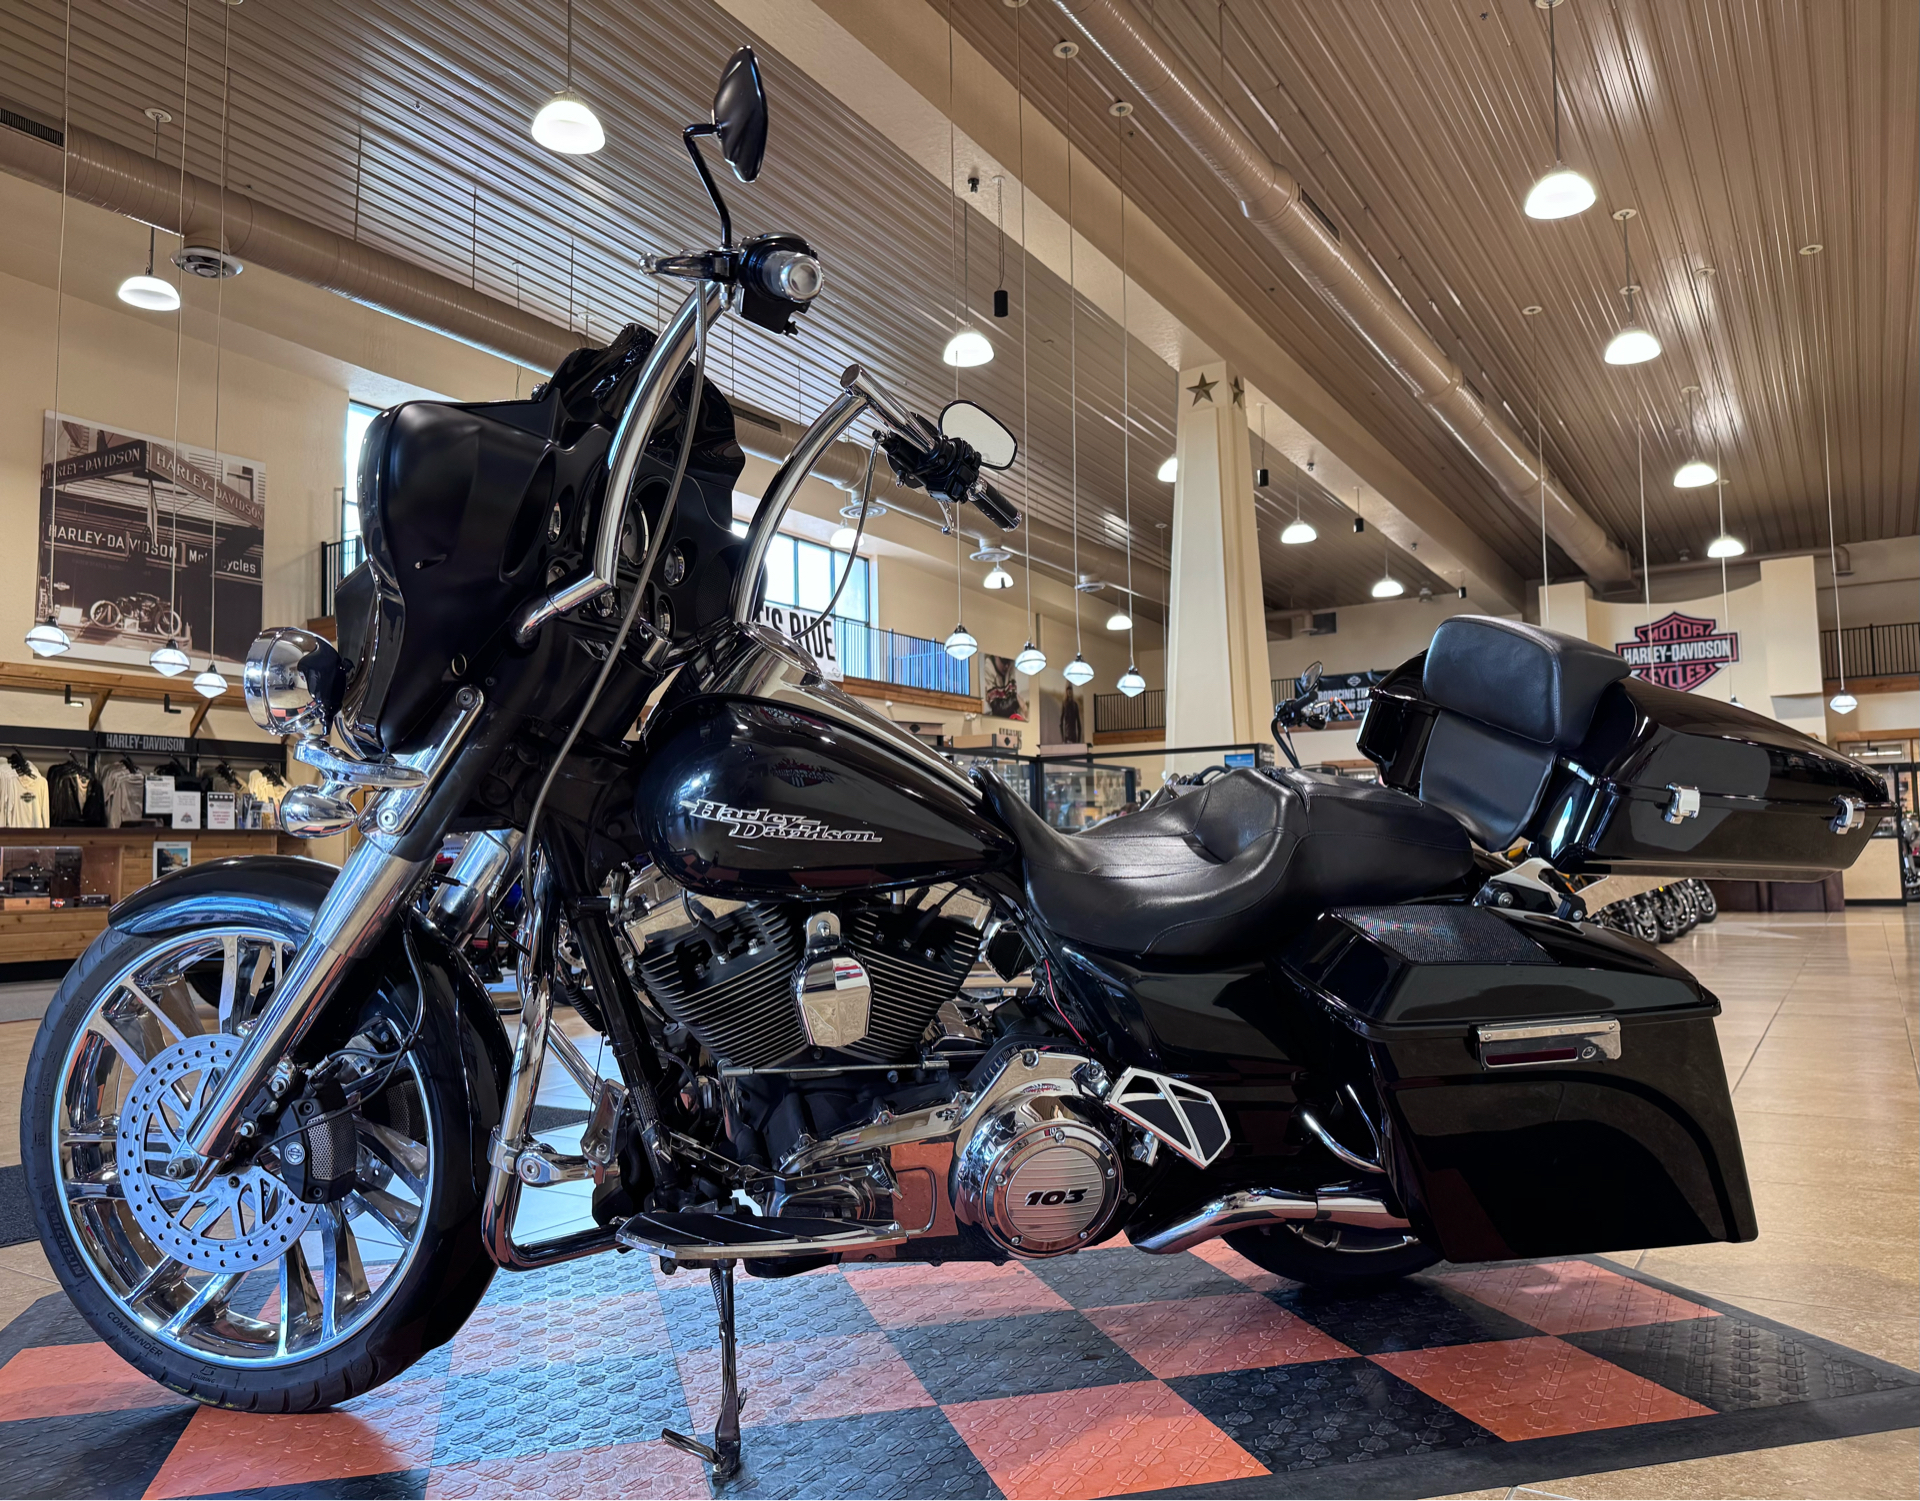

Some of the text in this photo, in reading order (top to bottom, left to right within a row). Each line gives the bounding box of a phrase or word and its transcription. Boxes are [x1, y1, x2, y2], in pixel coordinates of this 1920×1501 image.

[45, 447, 140, 480] HRLEY-DAVIDSON
[156, 451, 263, 522] HARLEY-DAVIDSON
[789, 611, 836, 662] RIDE
[1648, 619, 1704, 641] MOTOR
[1623, 639, 1730, 664] HARLEY-DAVIDSON
[1649, 664, 1706, 689] CYCLES
[106, 733, 185, 751] HARLEY-DAVIDSON
[729, 821, 883, 843] Davidson
[1025, 1187, 1089, 1206] 103
[49, 1211, 84, 1276] MICHELIN
[107, 1311, 163, 1357] COMMANDER
[191, 1372, 216, 1384] TOURING
